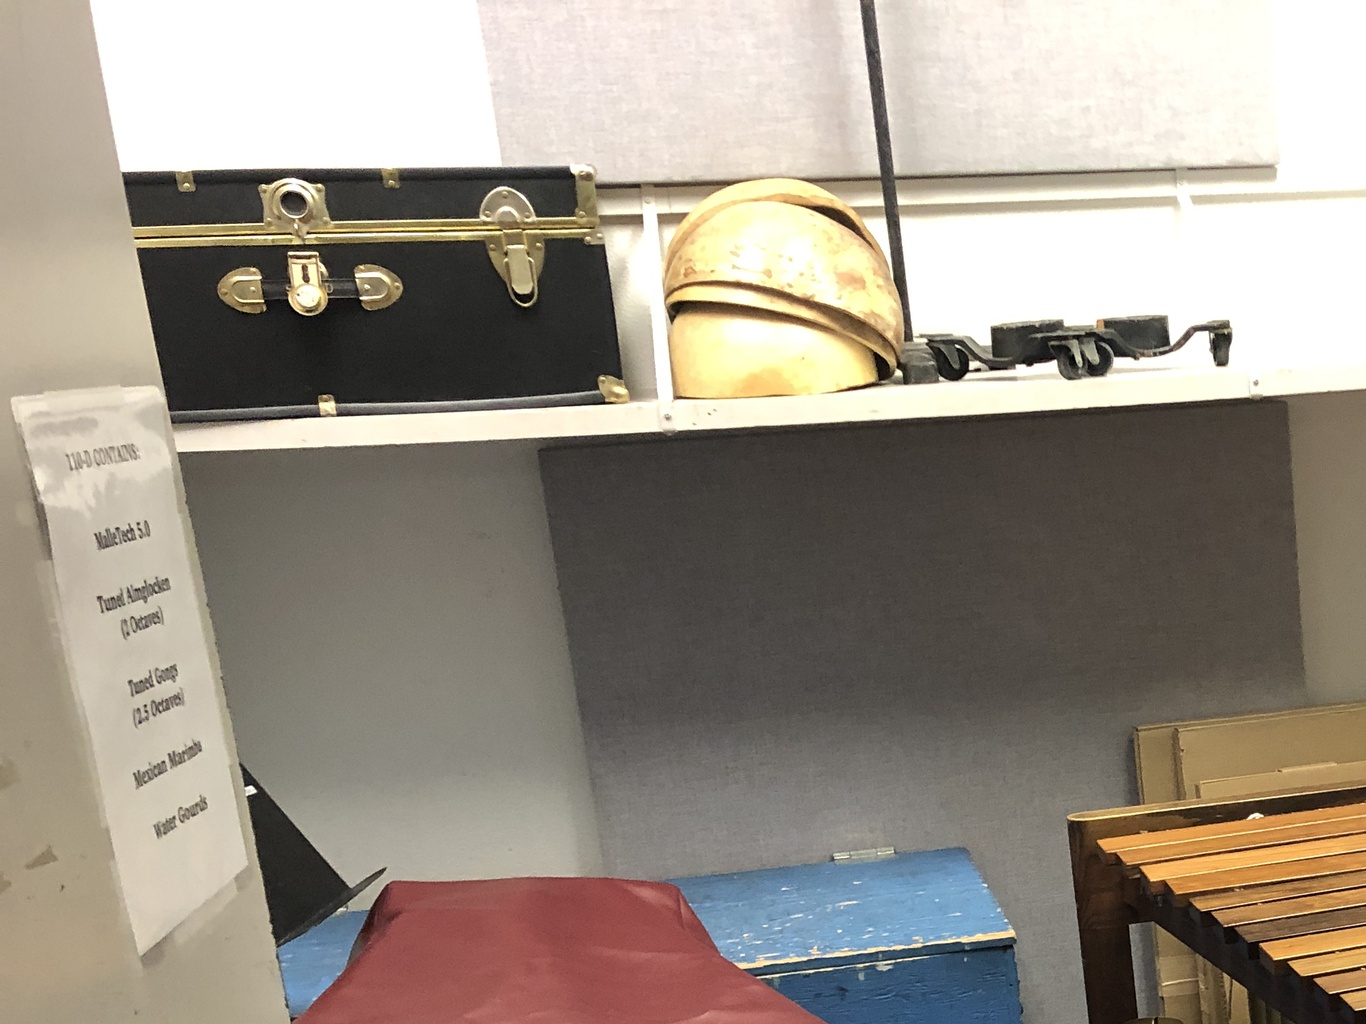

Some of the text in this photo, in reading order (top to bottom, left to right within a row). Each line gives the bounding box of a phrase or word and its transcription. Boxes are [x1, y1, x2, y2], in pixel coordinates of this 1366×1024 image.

[93, 443, 141, 466] CONTAINS:
[94, 520, 151, 550] MalleTech 5.0
[97, 587, 127, 614] Tuned
[130, 605, 165, 634] Octaves)
[127, 663, 179, 697] Tuned Gongs
[132, 687, 185, 729] (2.5 Octaves)
[132, 739, 203, 790] Mexican Marimba
[153, 794, 209, 840] Water Gourds
